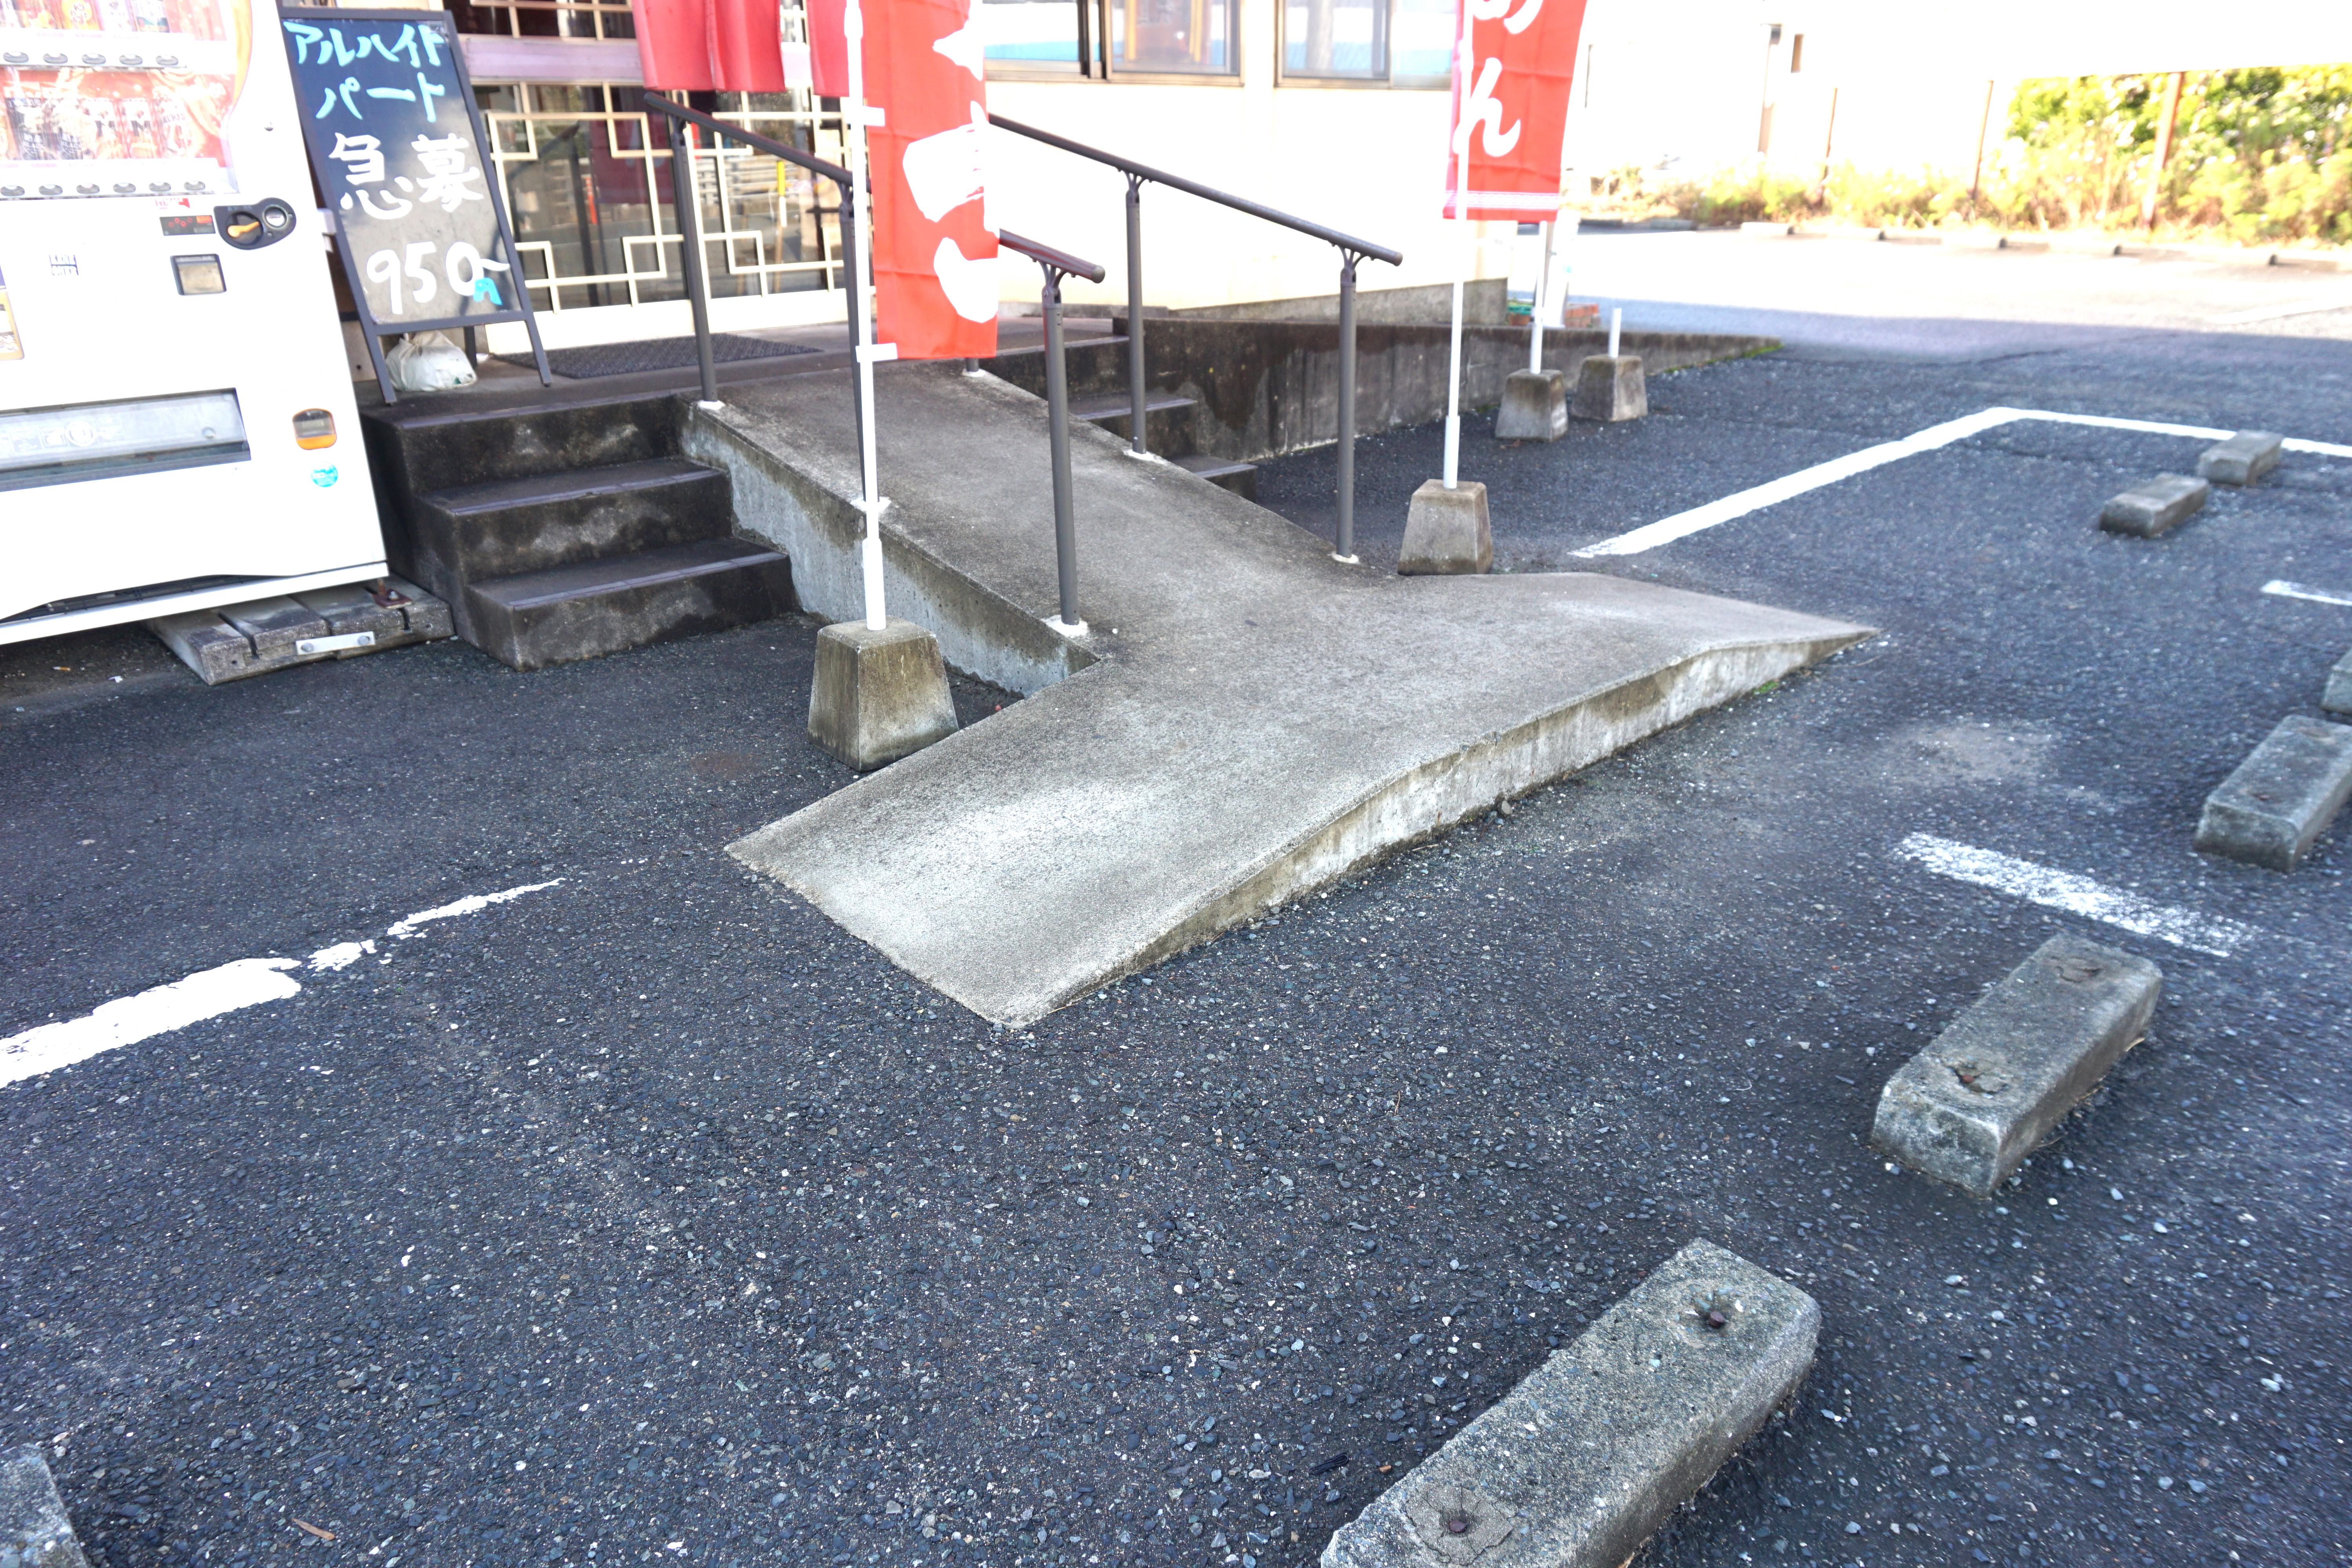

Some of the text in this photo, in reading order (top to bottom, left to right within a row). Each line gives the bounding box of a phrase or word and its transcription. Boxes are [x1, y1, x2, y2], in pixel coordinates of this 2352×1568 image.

[316, 72, 445, 123] パート
[328, 132, 484, 220] 急募
